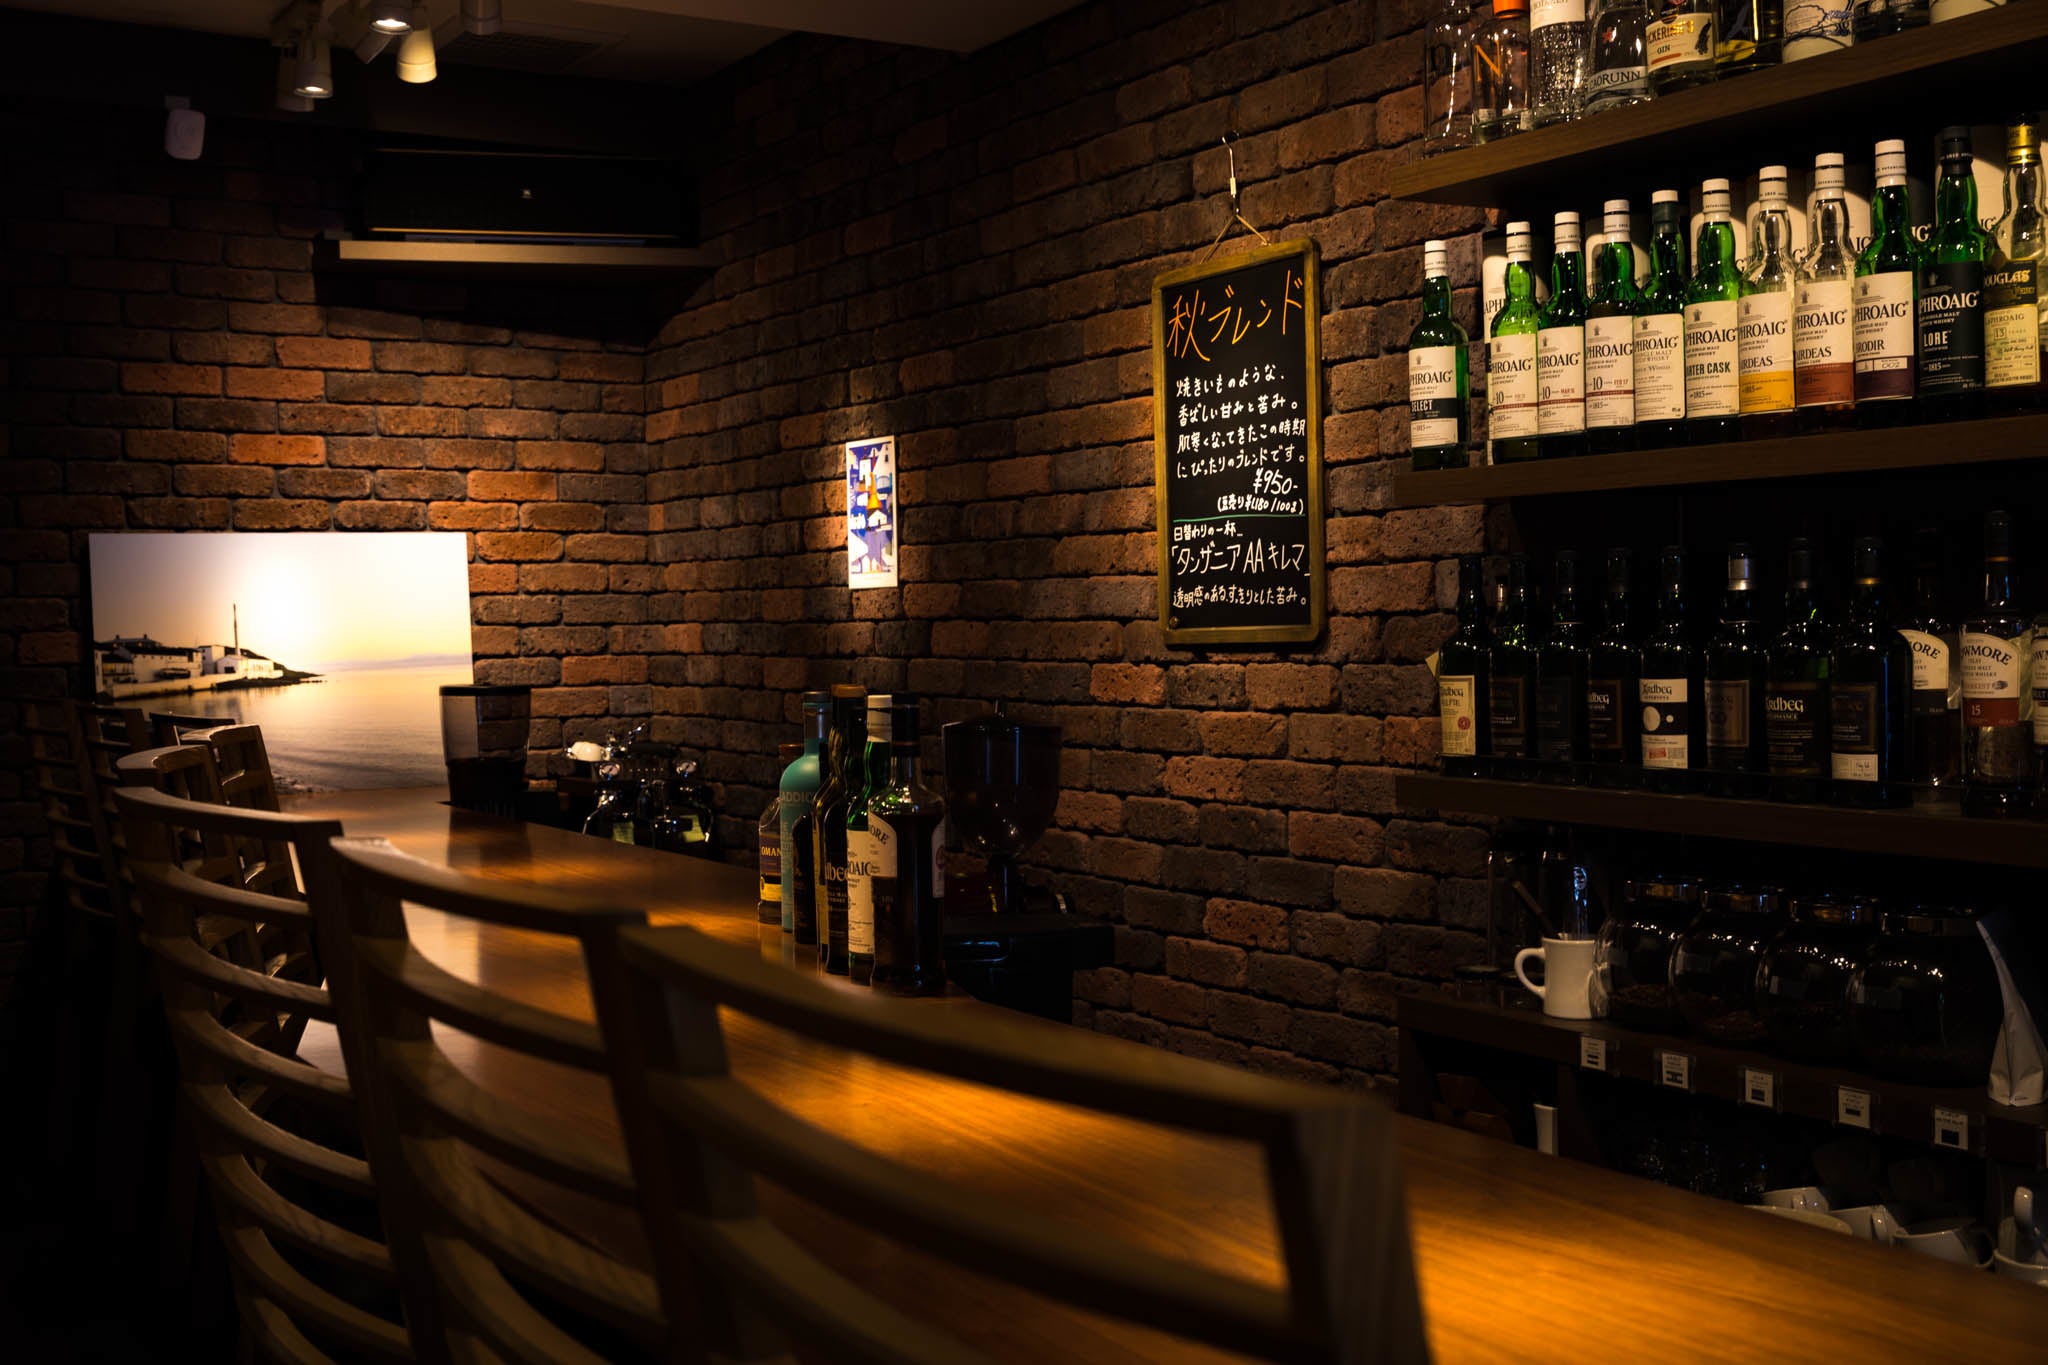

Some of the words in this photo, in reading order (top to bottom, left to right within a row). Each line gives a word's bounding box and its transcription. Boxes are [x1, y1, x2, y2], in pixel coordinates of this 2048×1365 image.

[1167, 269, 1303, 362] 秋ブレンド
[1924, 331, 1948, 347] LORE
[1707, 362, 1731, 374] CASK
[1592, 376, 1603, 390] 10
[1495, 391, 1504, 404] 10
[1542, 386, 1551, 400] 10
[1178, 392, 1299, 427] 香ばしい甘みと苦み。
[1176, 417, 1306, 454] 肌寒くなってきたこの時期
[1176, 443, 1305, 479] にぴったりのブレンドです。
[1971, 704, 1981, 716] 15
